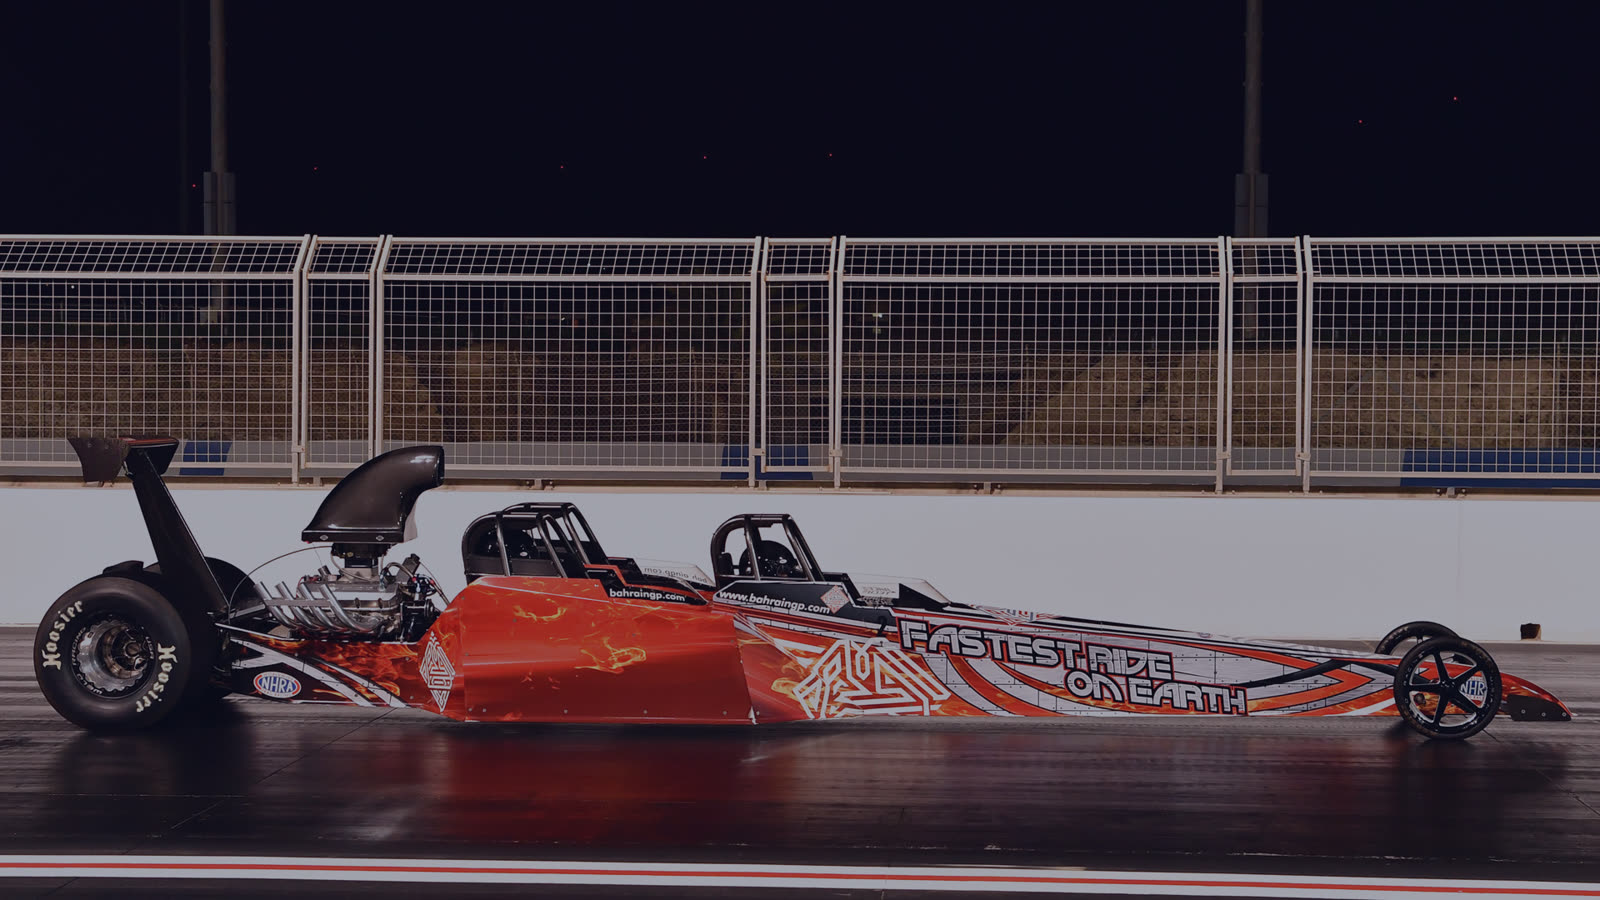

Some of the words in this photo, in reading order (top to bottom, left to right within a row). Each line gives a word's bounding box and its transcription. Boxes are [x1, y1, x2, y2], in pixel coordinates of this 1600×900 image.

[609, 588, 685, 602] bahraingp.com
[719, 591, 831, 614] www.bahraingp.com
[41, 600, 83, 671] Hoosier
[898, 619, 1083, 670] FASTEST
[1086, 643, 1174, 681] RIDE
[135, 643, 178, 713] Hoosier
[261, 676, 294, 693] NHRA
[1064, 669, 1125, 702] ON
[1126, 677, 1248, 716] EARTH
[1460, 680, 1487, 696] NHR
